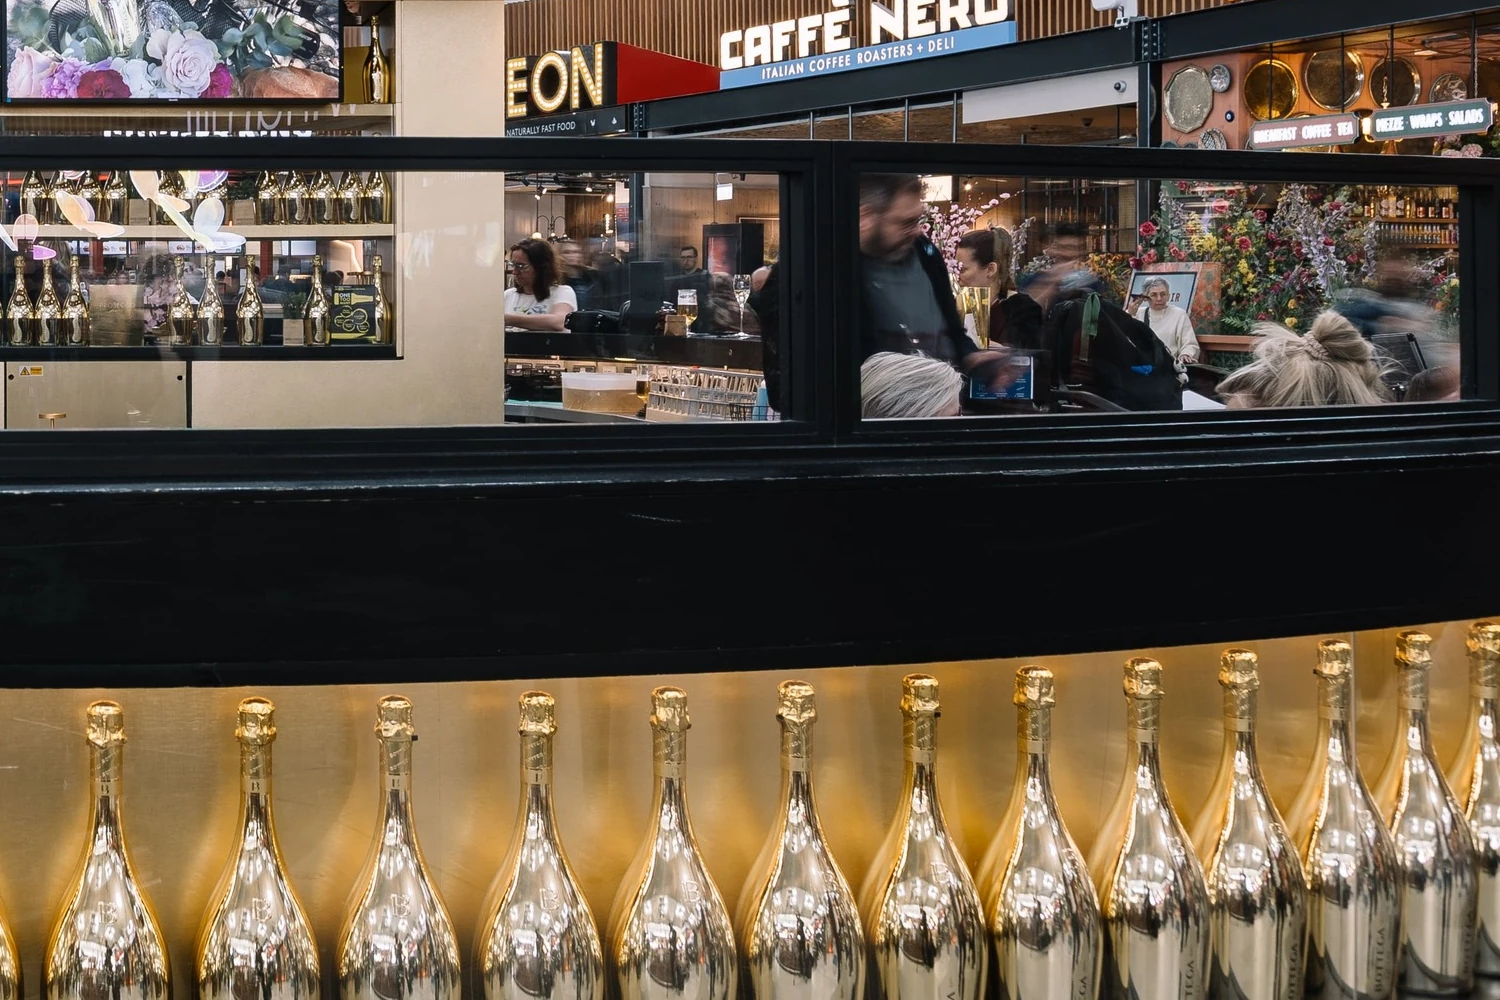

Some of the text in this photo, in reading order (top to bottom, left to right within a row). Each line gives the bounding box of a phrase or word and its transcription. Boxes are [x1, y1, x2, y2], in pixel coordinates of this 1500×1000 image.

[762, 62, 804, 80] ITALIAN
[809, 54, 851, 72] COFFEE
[857, 43, 913, 65] ROASTERS
[928, 36, 955, 53] DELI
[506, 121, 576, 137] NATURALLY FAST FOOD
[1301, 123, 1332, 140] COFFEE
[1337, 121, 1354, 137] TEA
[1375, 118, 1484, 143] MEZZE WRAPS SALADS
[1374, 927, 1385, 993] BOTTEGA
